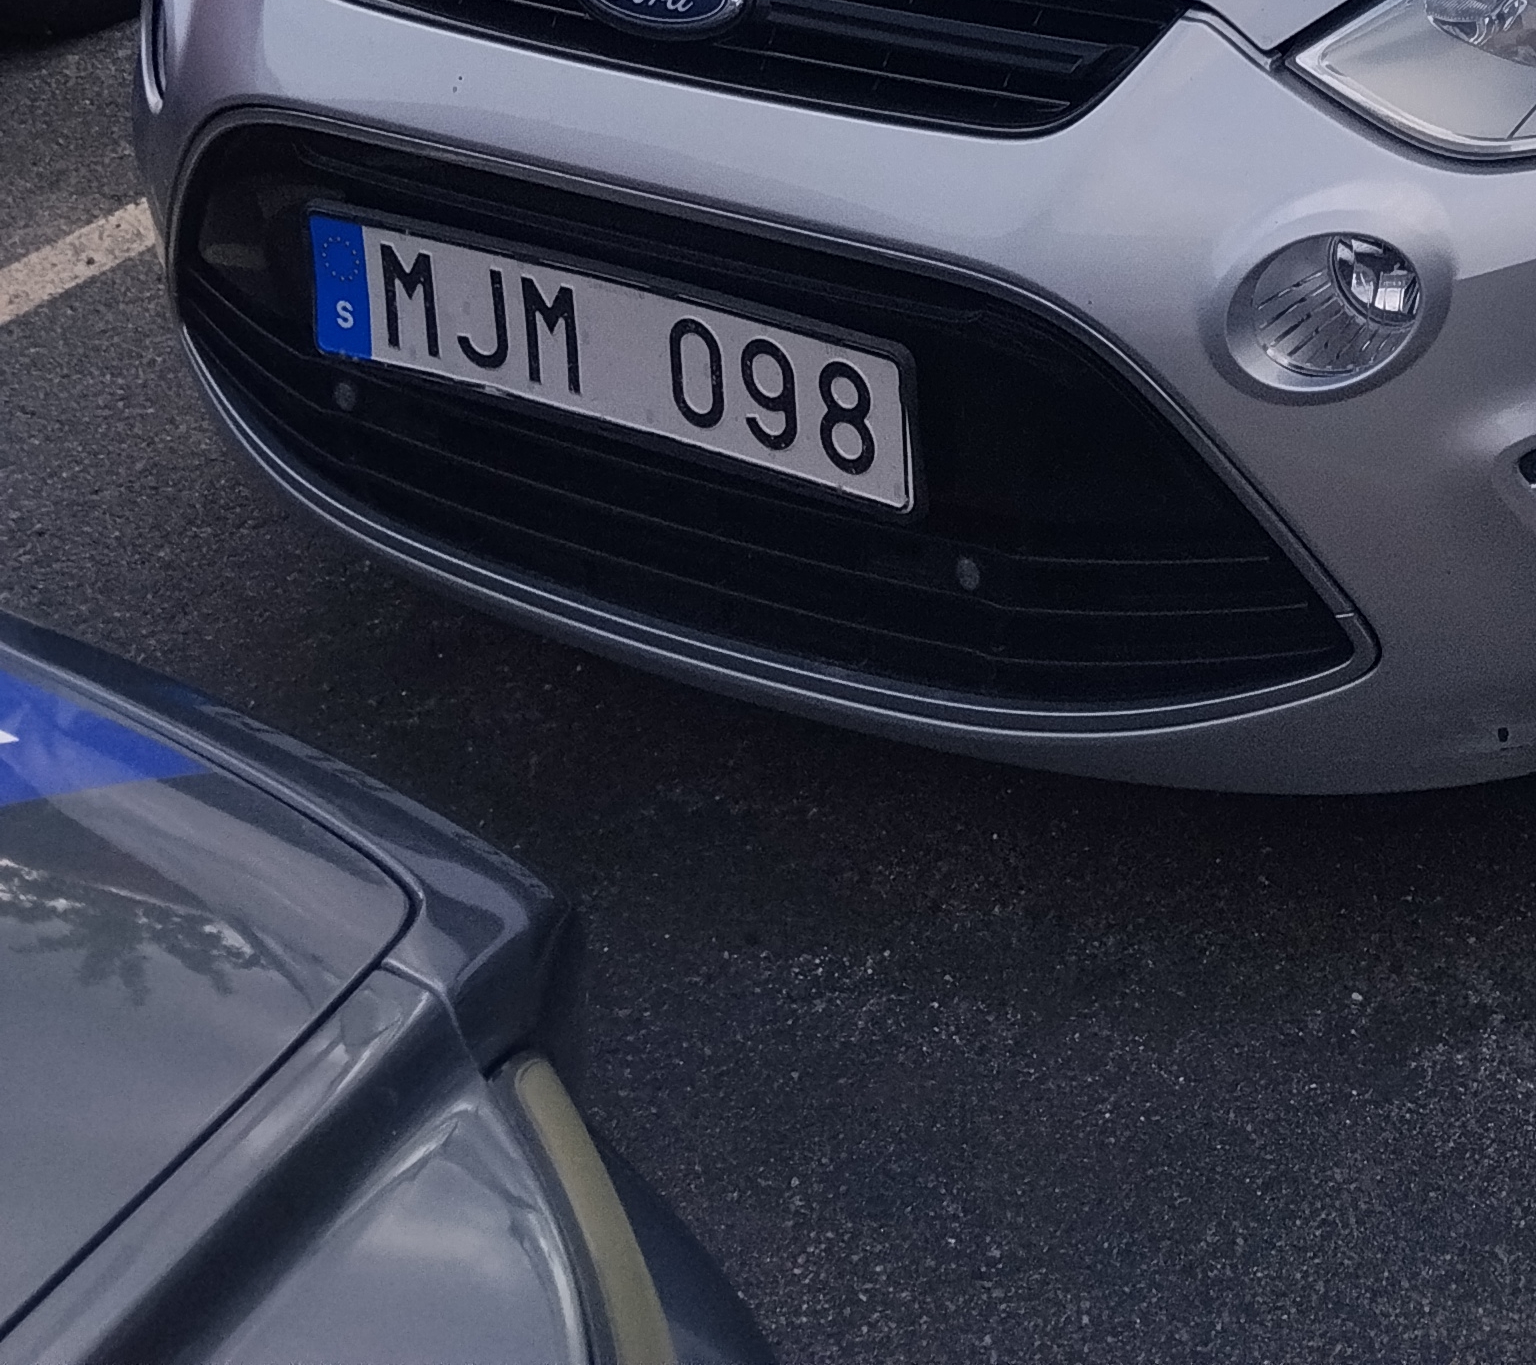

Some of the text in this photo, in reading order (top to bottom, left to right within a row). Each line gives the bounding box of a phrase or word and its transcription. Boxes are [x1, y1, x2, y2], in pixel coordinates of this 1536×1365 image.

[336, 300, 354, 329] S
[379, 242, 876, 475] MJM 098
